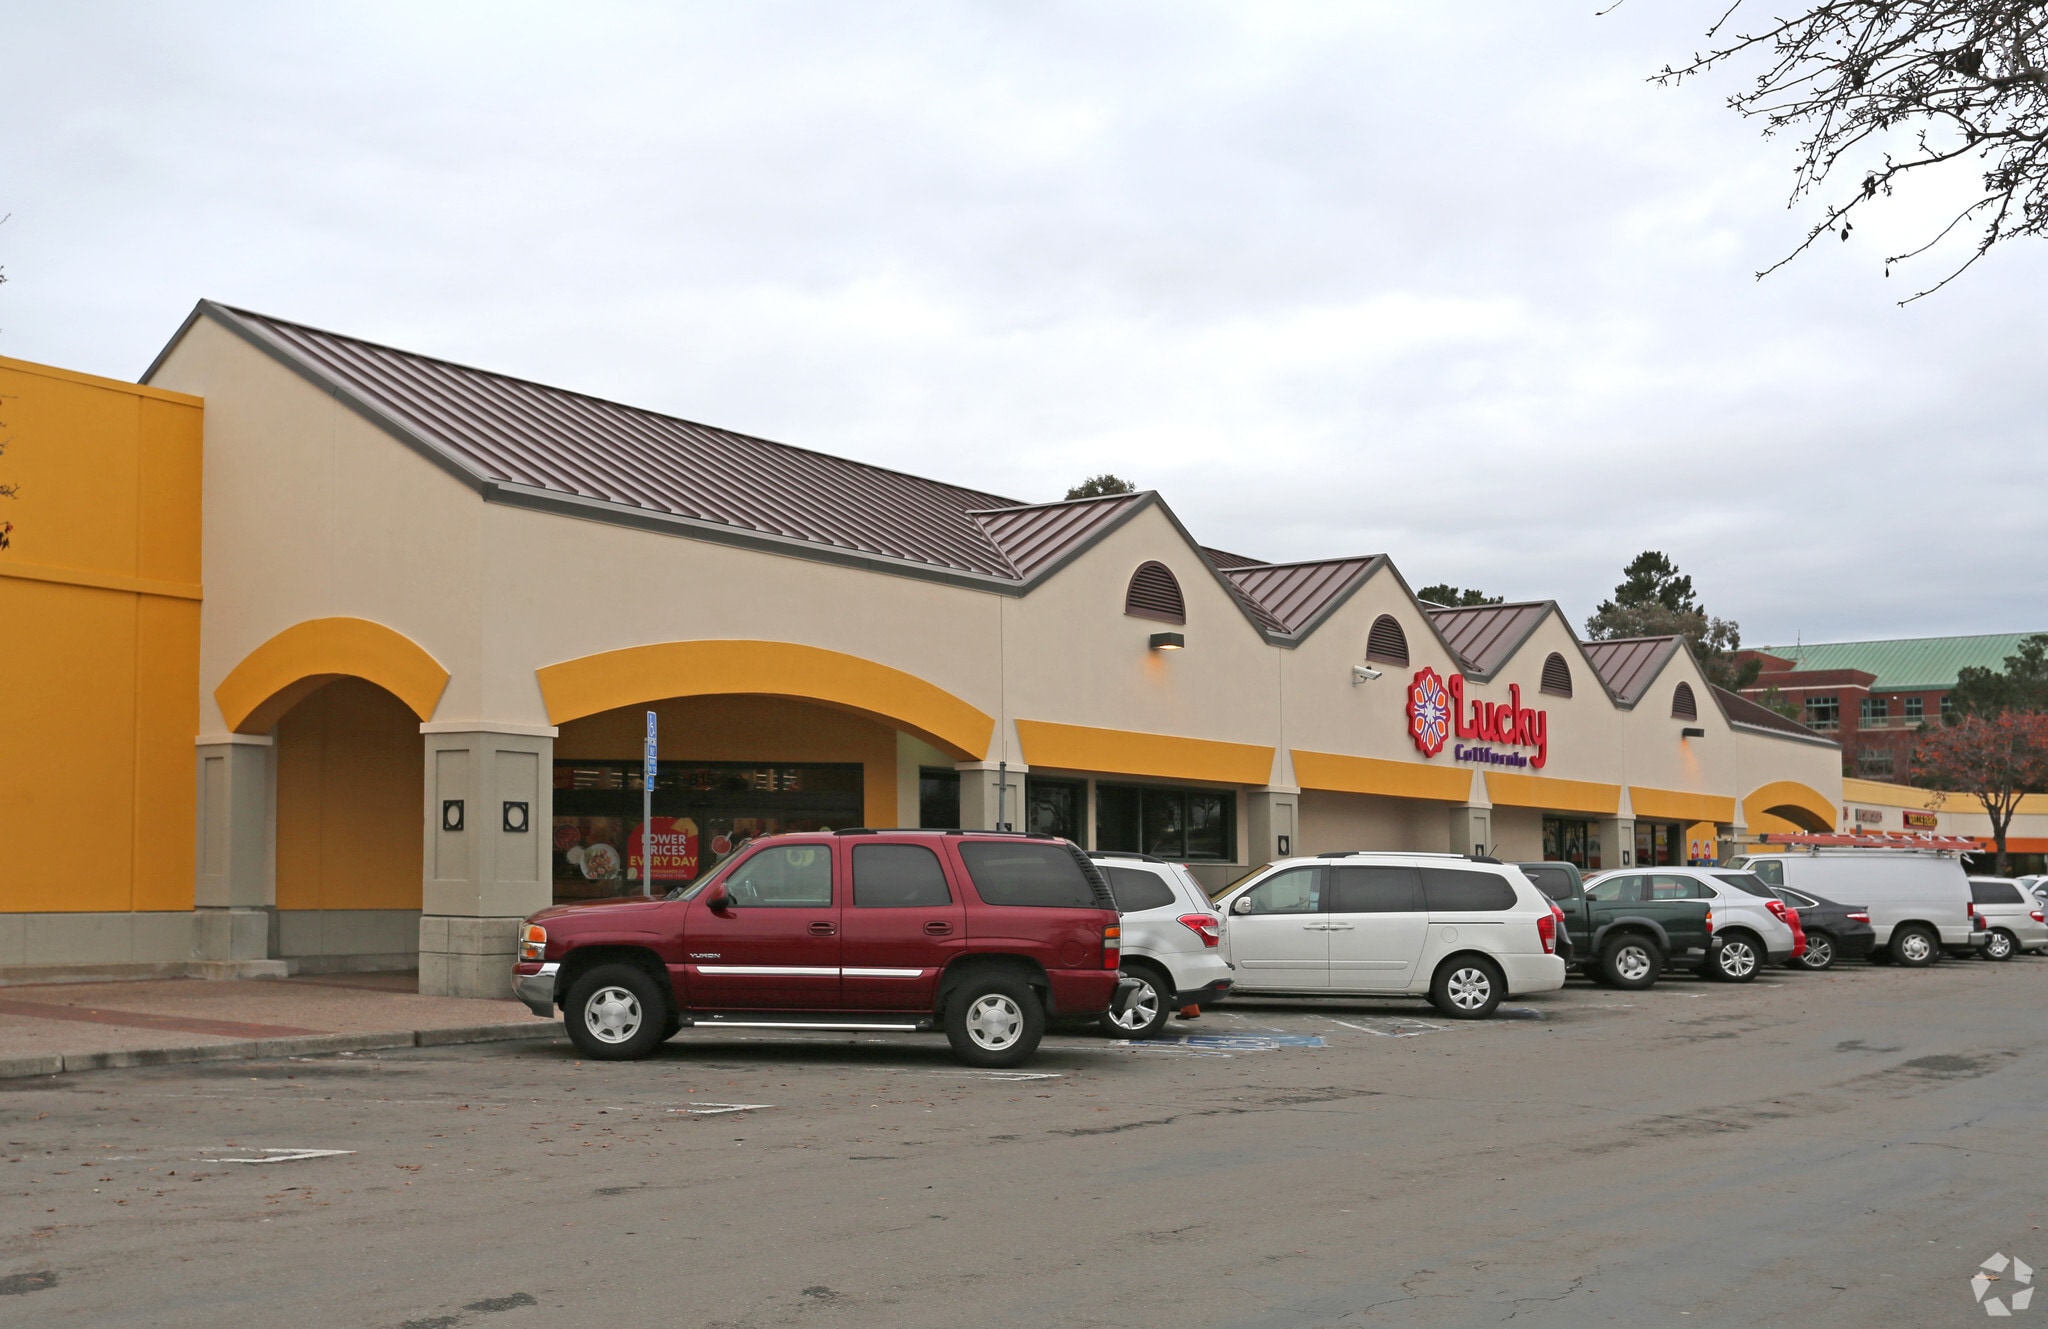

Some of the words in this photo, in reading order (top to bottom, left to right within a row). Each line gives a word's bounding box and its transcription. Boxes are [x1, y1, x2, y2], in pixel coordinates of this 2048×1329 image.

[1448, 674, 1546, 768] Lucky
[1455, 744, 1527, 767] California
[642, 845, 686, 855] RICES
[630, 856, 669, 866] EVRY
[672, 856, 697, 866] DAY
